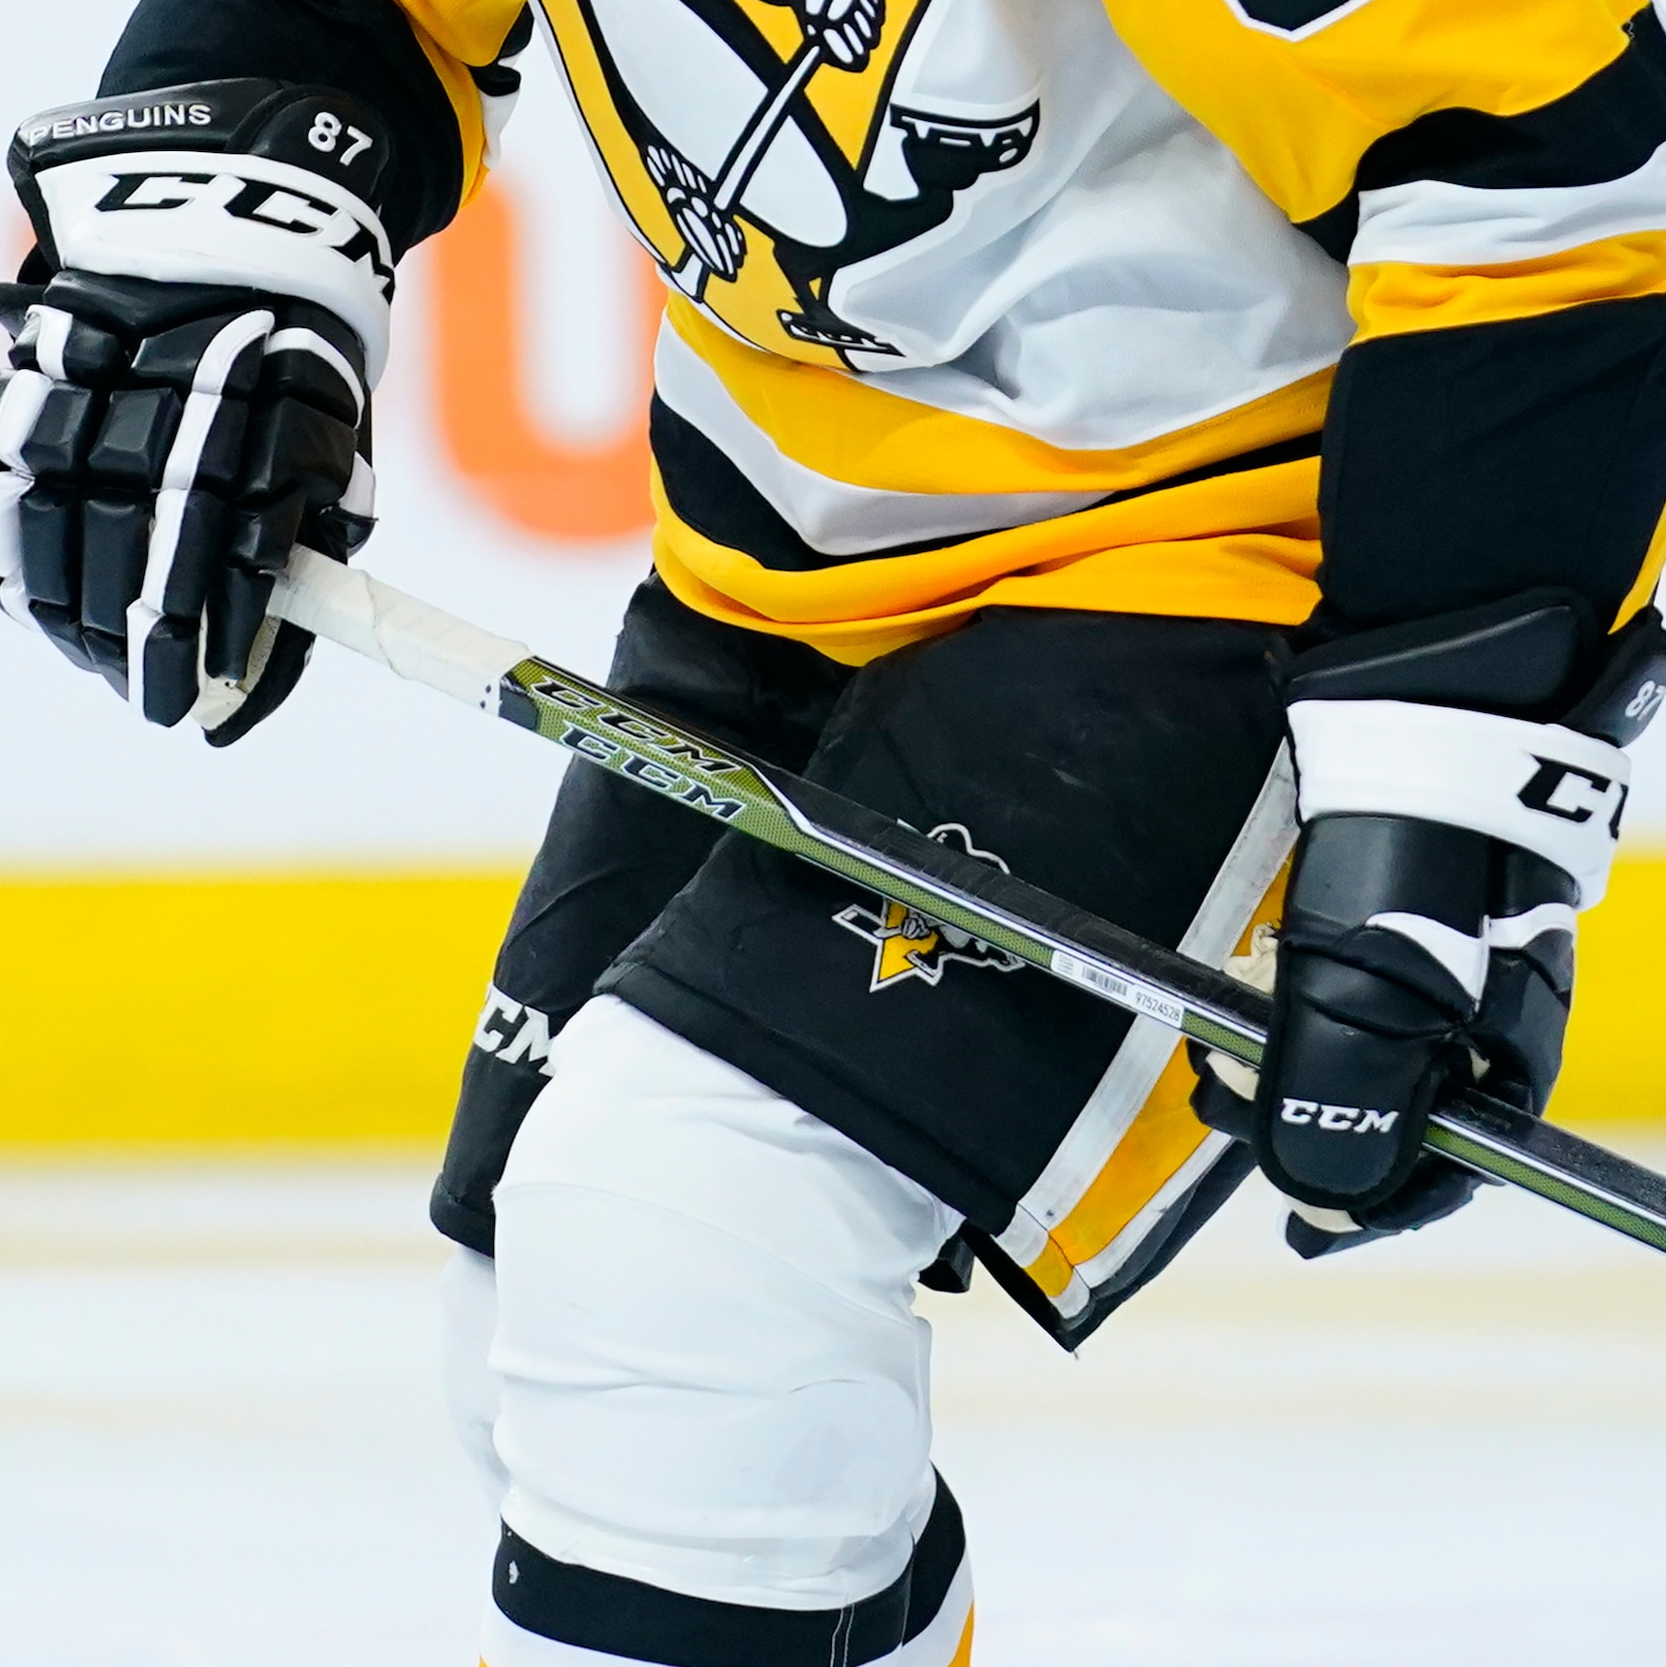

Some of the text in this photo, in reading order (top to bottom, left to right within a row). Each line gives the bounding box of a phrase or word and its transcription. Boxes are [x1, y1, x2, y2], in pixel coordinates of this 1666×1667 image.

[26, 103, 212, 147] PENGUINS
[308, 112, 374, 167] 87
[532, 675, 741, 774] CCM
[559, 720, 746, 821] CCM
[474, 981, 556, 1078] CM
[1281, 1098, 1399, 1133] CCM
